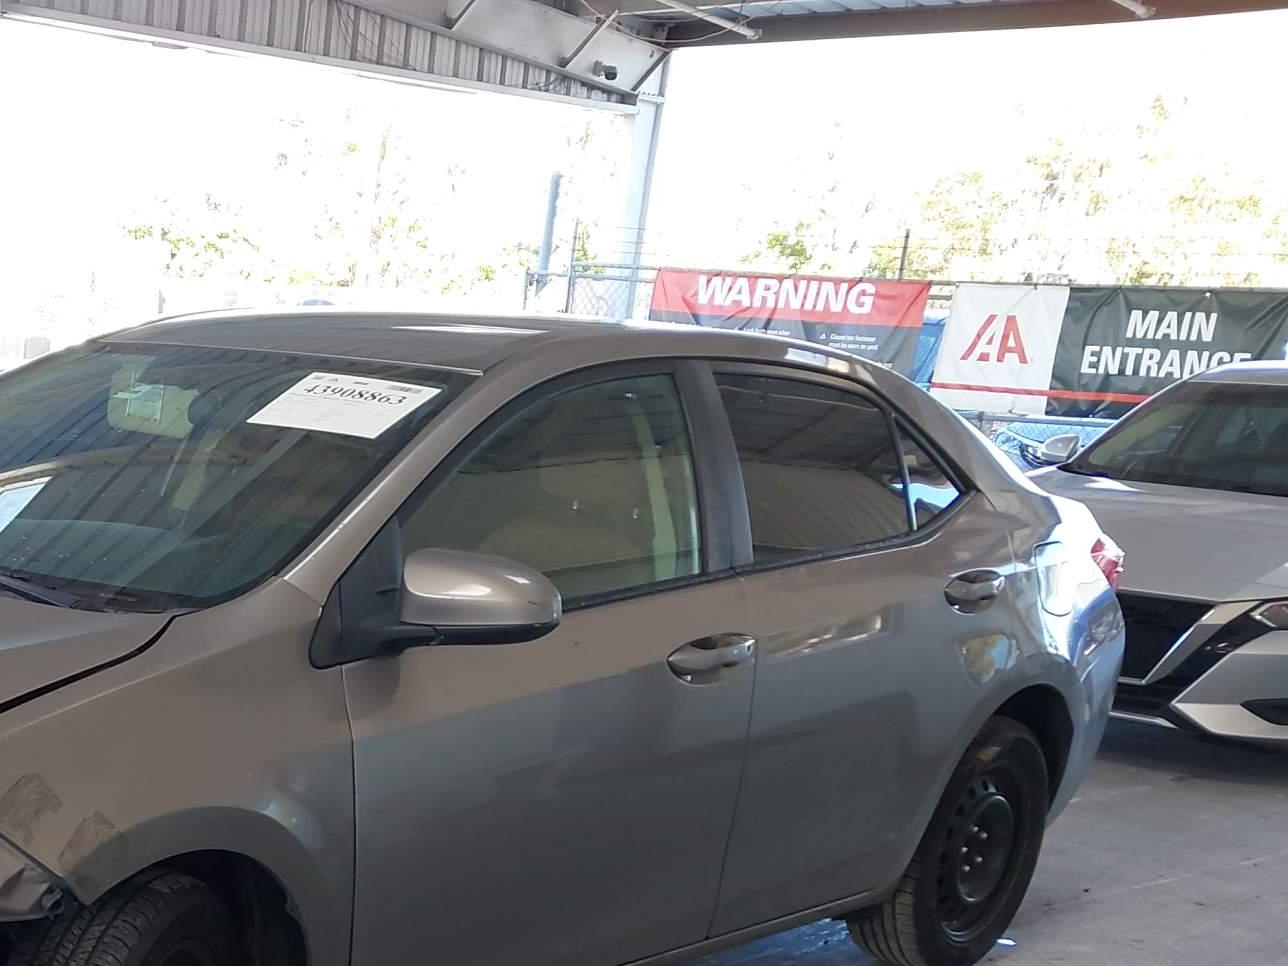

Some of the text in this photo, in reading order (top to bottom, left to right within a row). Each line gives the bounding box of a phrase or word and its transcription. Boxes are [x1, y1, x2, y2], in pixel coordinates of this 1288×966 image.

[697, 275, 876, 314] WARNING
[1125, 310, 1218, 342] MAIN
[303, 384, 408, 405] 43908863
